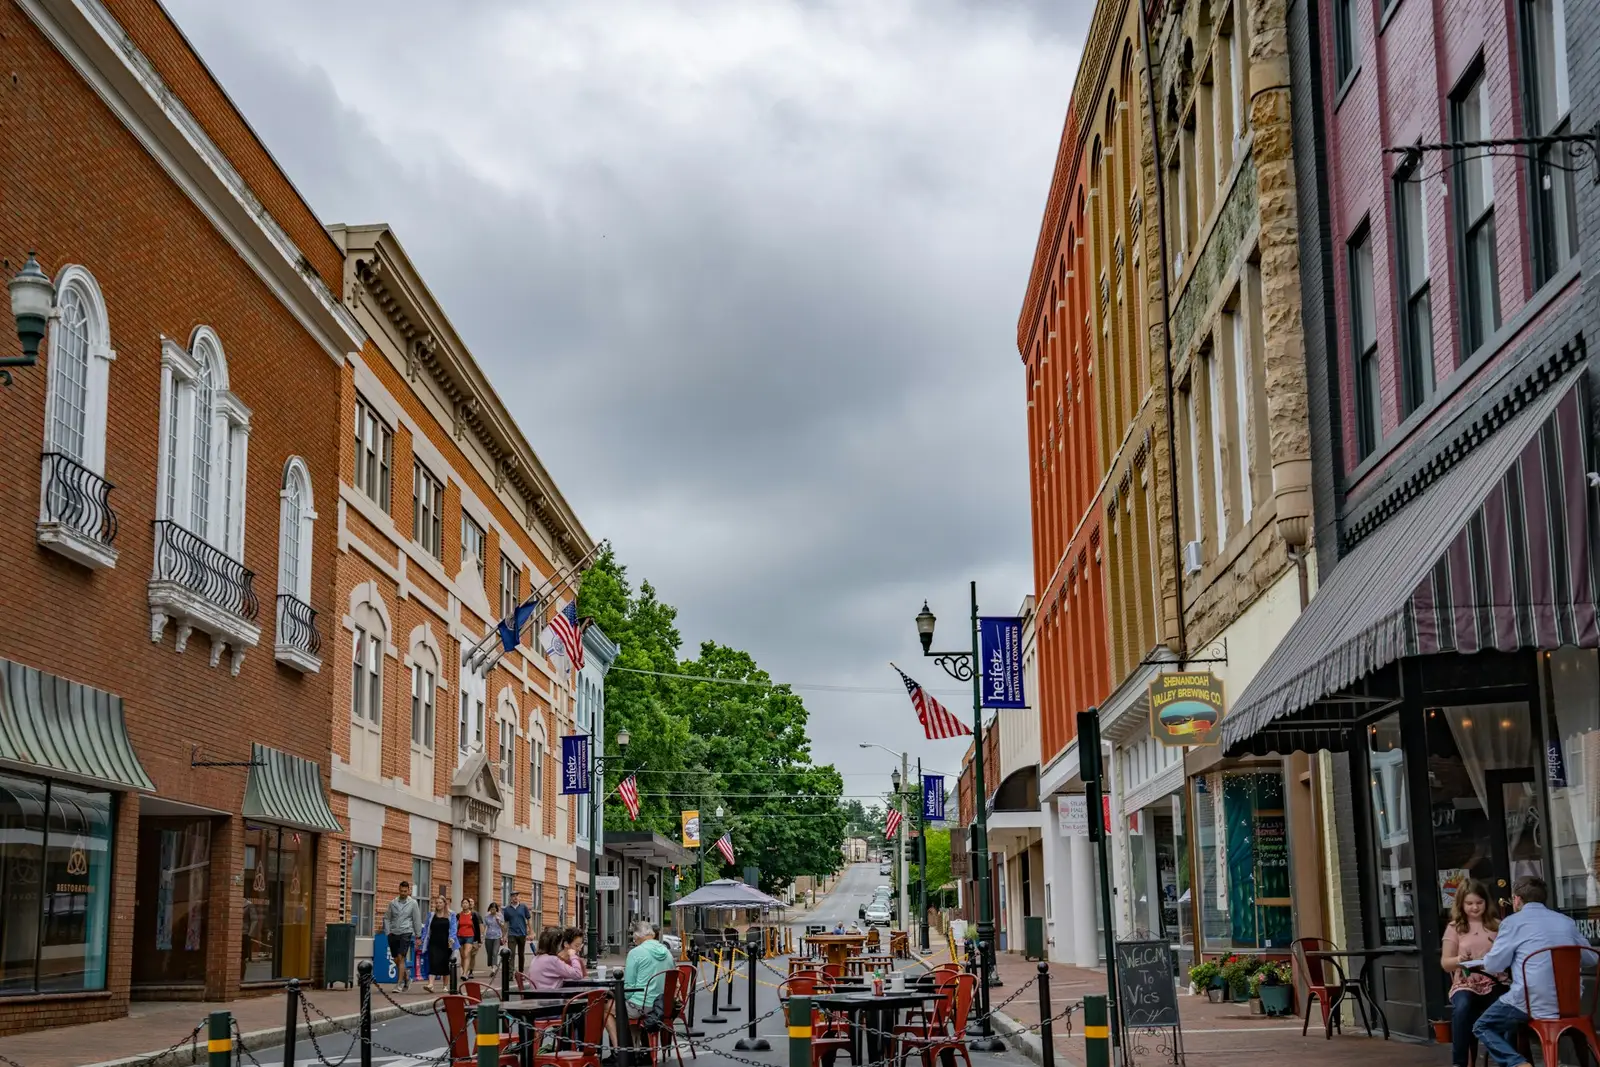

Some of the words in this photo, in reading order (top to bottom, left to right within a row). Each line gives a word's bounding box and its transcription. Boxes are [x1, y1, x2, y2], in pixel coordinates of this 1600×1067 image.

[988, 648, 1005, 701] heifetz
[1012, 662, 1019, 671] OF
[1013, 671, 1021, 701] FESTIVAL
[1163, 675, 1210, 688] SHENANDOAH
[1152, 689, 1177, 708] VALLEY
[1177, 687, 1210, 701] BREWING
[1210, 691, 1223, 707] CO.
[565, 755, 577, 790] heifetz
[926, 789, 935, 816] heifetz
[56, 883, 96, 893] RESTORATION
